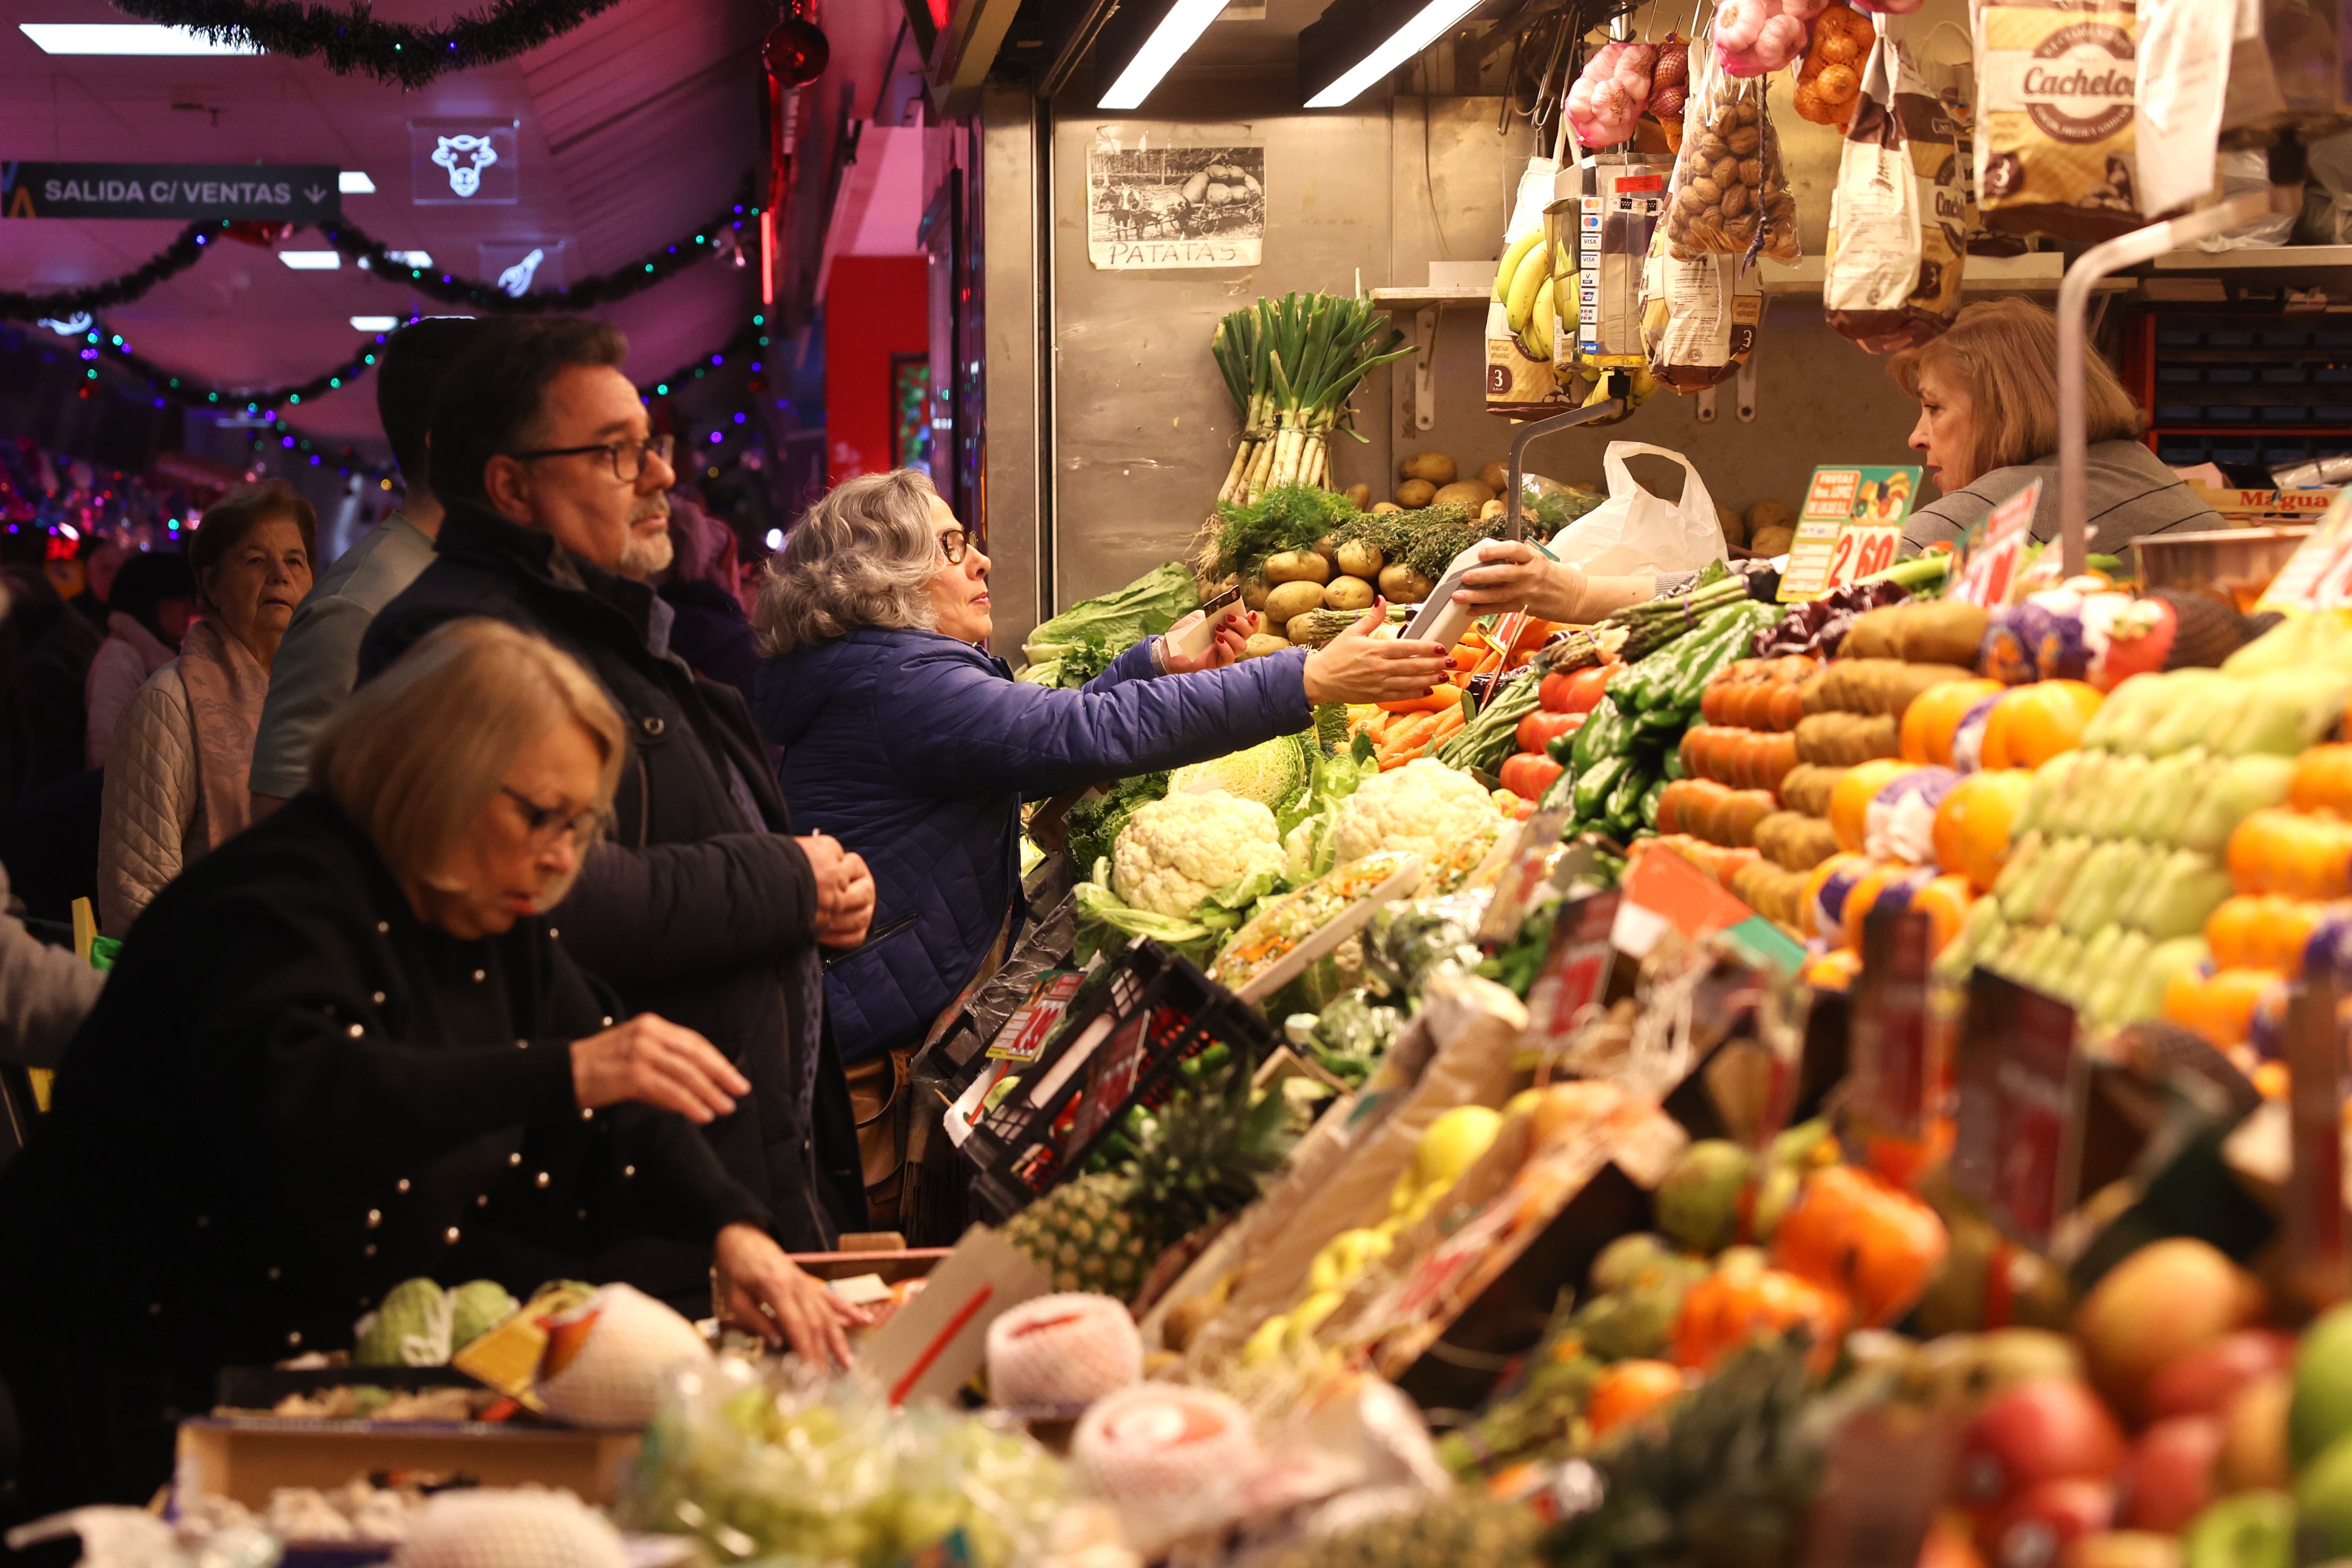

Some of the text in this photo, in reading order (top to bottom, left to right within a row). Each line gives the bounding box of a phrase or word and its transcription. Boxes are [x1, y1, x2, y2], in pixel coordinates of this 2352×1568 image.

[45, 180, 291, 205] SALIDA C/ VENTAS
[1109, 242, 1237, 265] PATATAS
[1742, 330, 1752, 348] 3
[1494, 369, 1503, 387] 3
